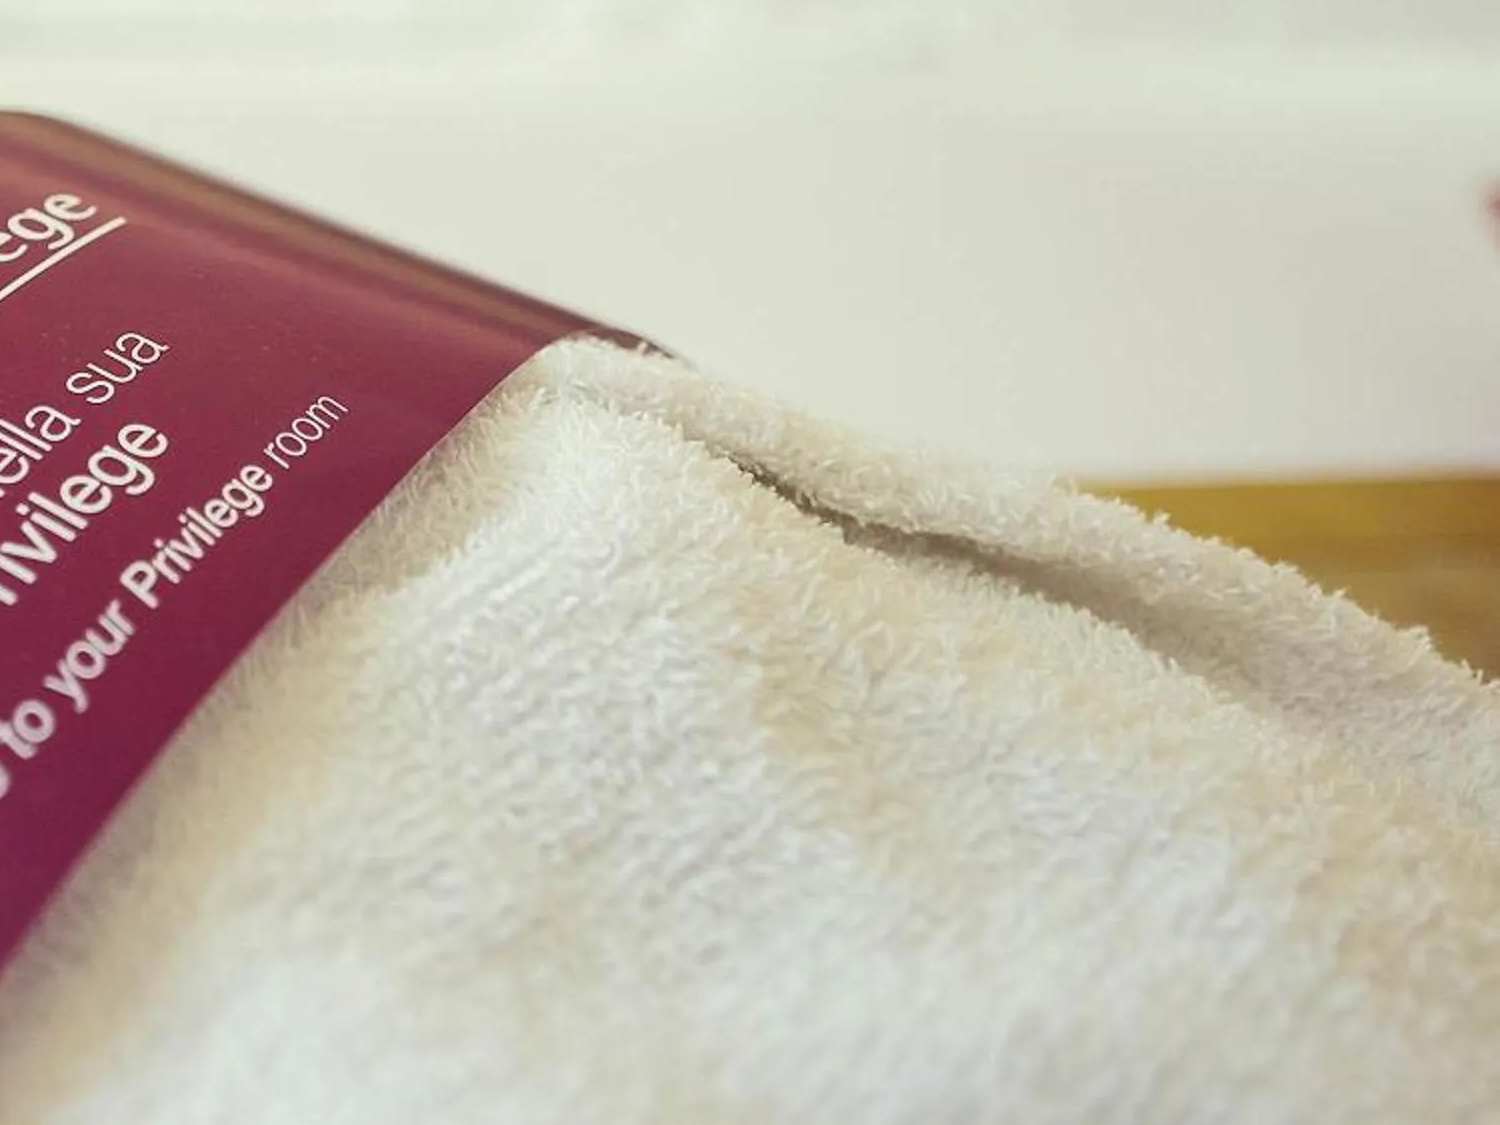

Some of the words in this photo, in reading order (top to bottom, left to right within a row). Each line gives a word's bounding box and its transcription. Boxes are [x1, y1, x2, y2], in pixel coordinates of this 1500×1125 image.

[64, 331, 170, 405] sua
[44, 599, 135, 714] your
[119, 461, 273, 610] Privilege
[263, 392, 349, 470] room
